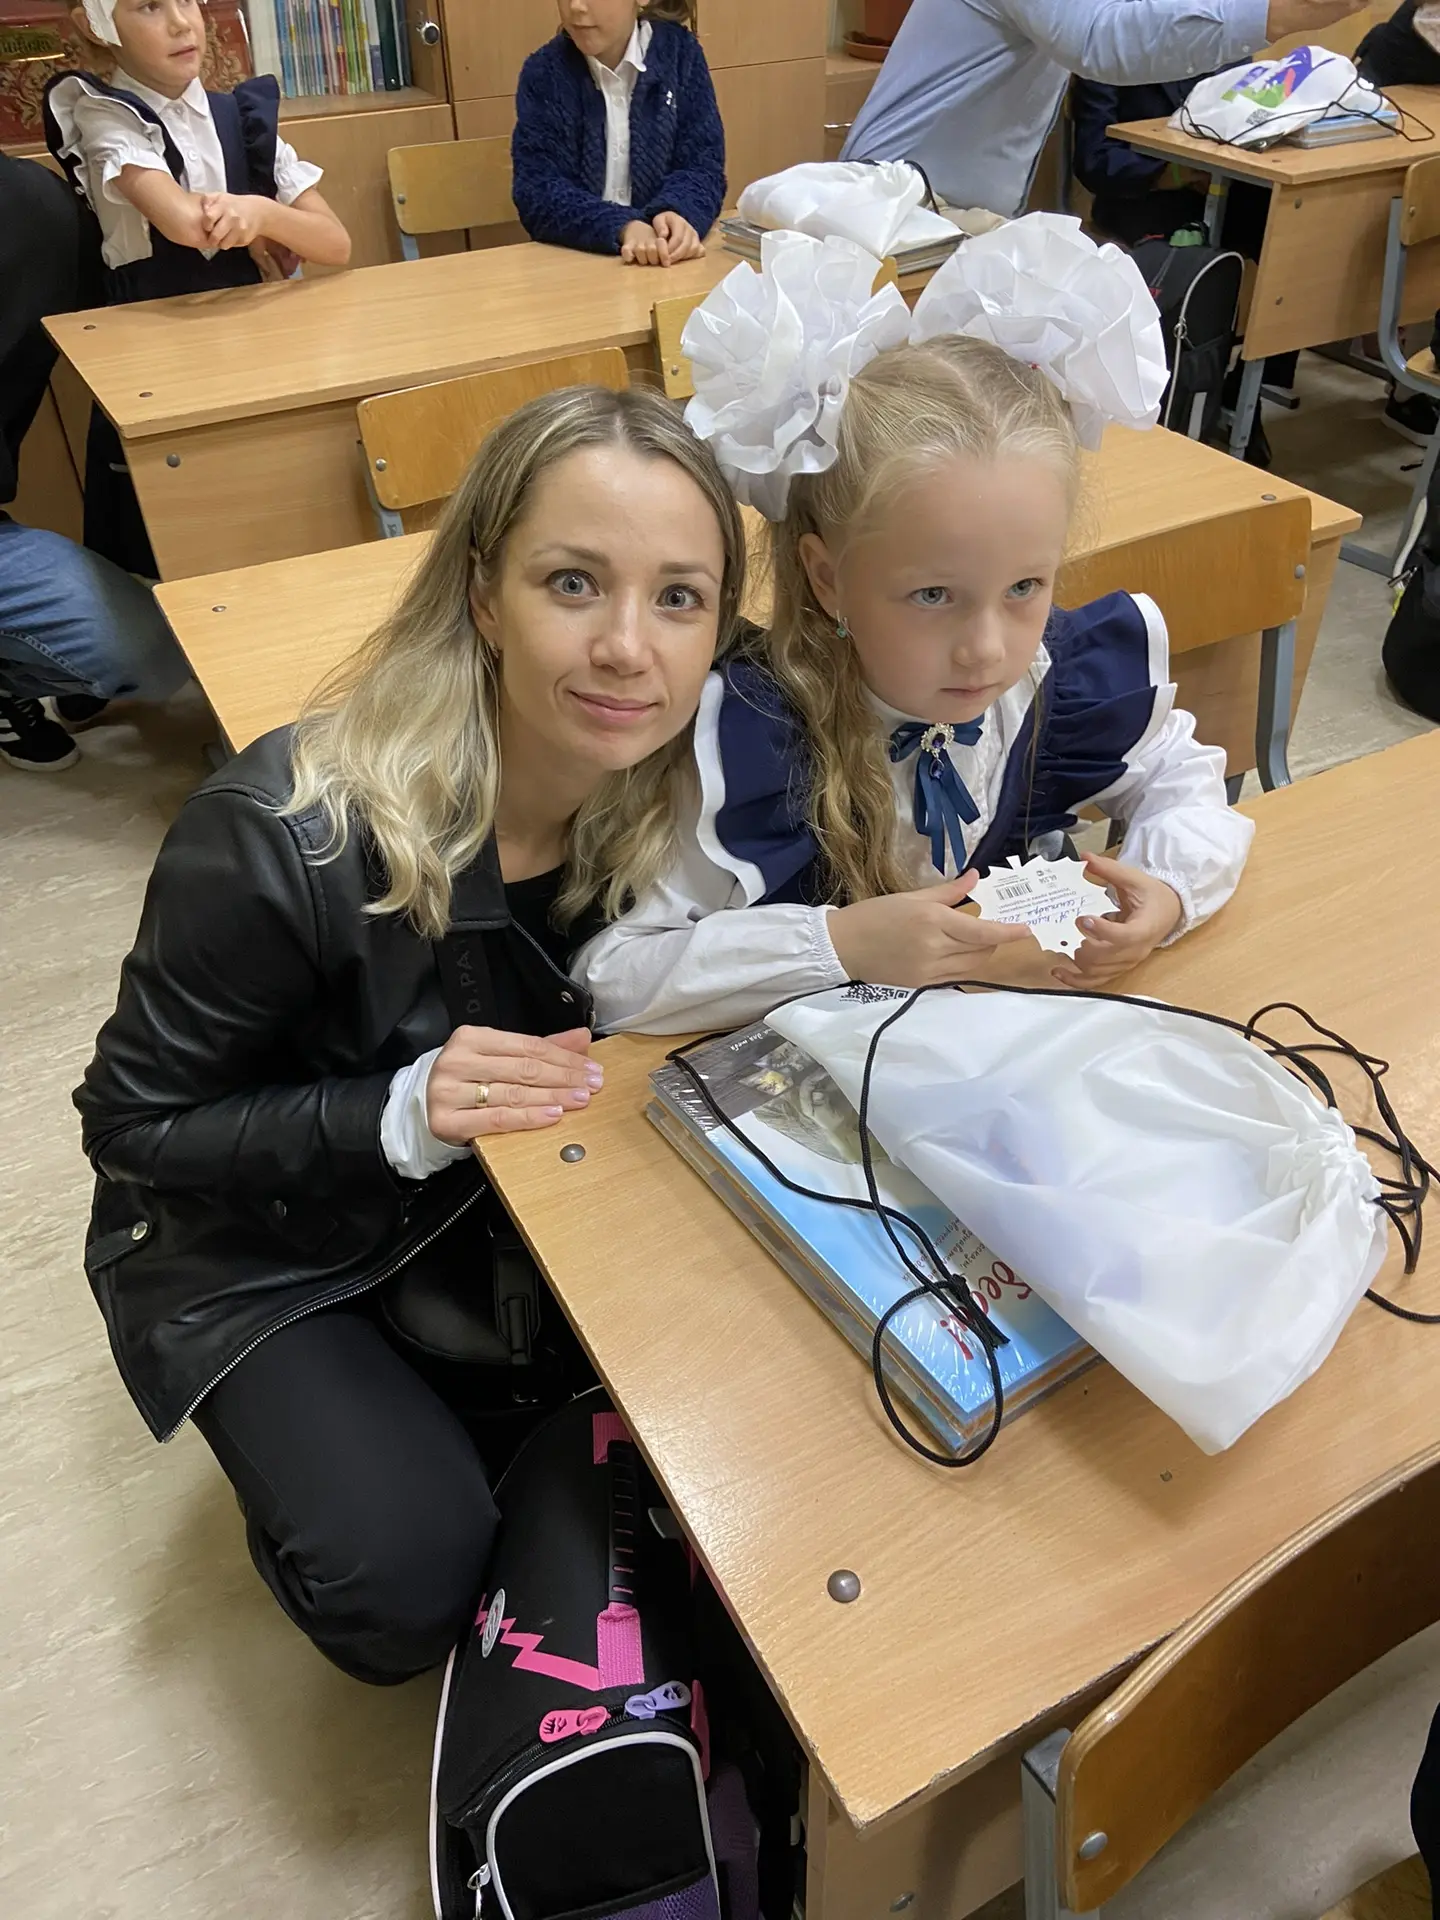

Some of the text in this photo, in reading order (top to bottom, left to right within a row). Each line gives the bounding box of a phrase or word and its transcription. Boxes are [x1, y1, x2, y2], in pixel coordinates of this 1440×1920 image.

[1024, 899, 1076, 916] сентября
[729, 1032, 763, 1052] для тебя
